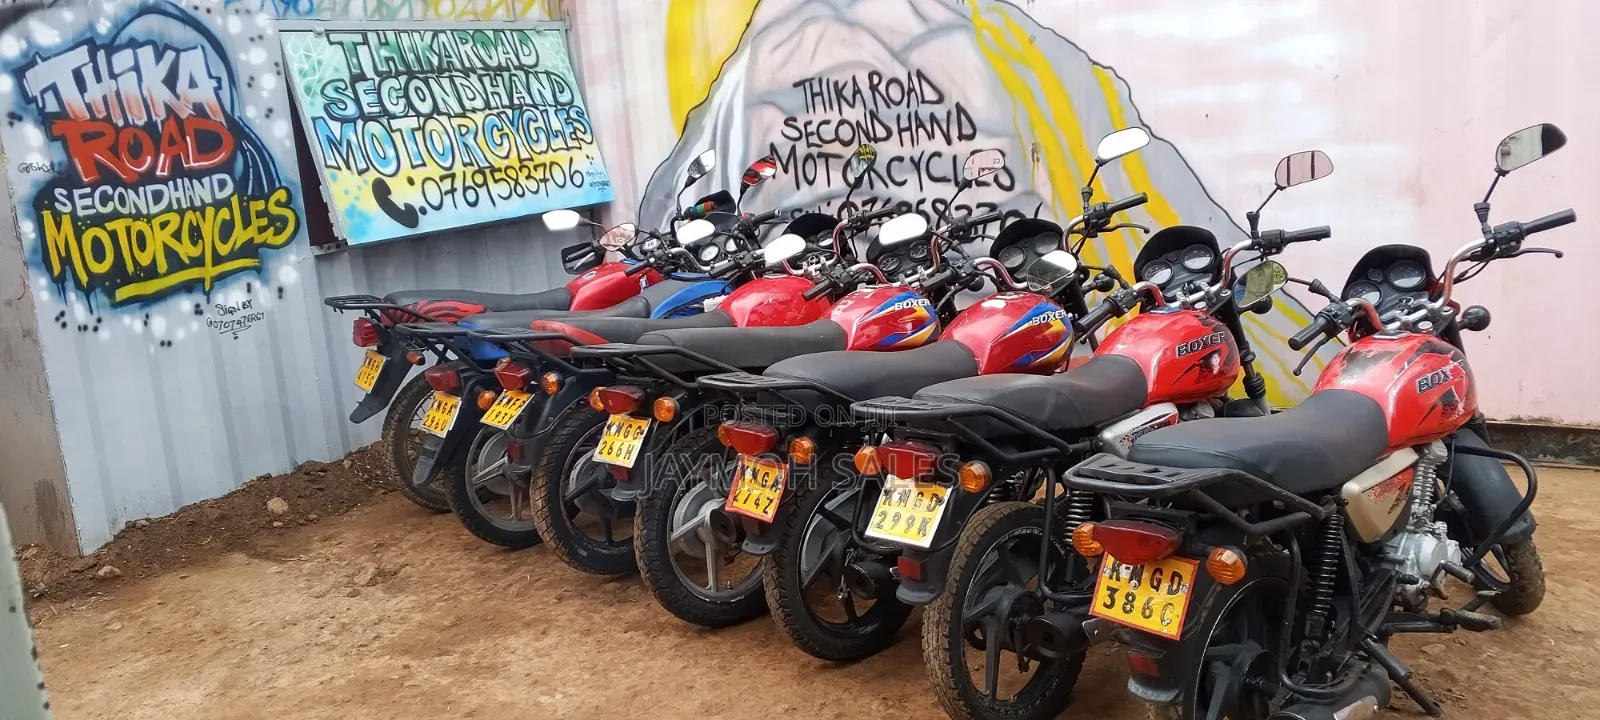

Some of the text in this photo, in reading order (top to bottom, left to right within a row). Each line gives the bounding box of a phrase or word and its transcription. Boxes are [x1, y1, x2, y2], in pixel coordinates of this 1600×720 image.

[868, 69, 945, 110] ROAD
[313, 105, 594, 177] MOTORCYCLES
[781, 102, 977, 148] SECOND HAND
[52, 116, 235, 183] ROAD
[54, 173, 234, 216] SECONDHAND
[42, 188, 299, 289] MOTORCYCLES
[242, 299, 252, 309] BY
[894, 298, 931, 311] BOXER
[1031, 309, 1067, 326] BOXER
[1176, 331, 1226, 358] BOXER
[598, 441, 635, 460] 266H
[882, 488, 940, 513] KMGD
[874, 510, 931, 537] 299K
[1109, 560, 1184, 596] KMGD
[1103, 585, 1176, 627] 386C
